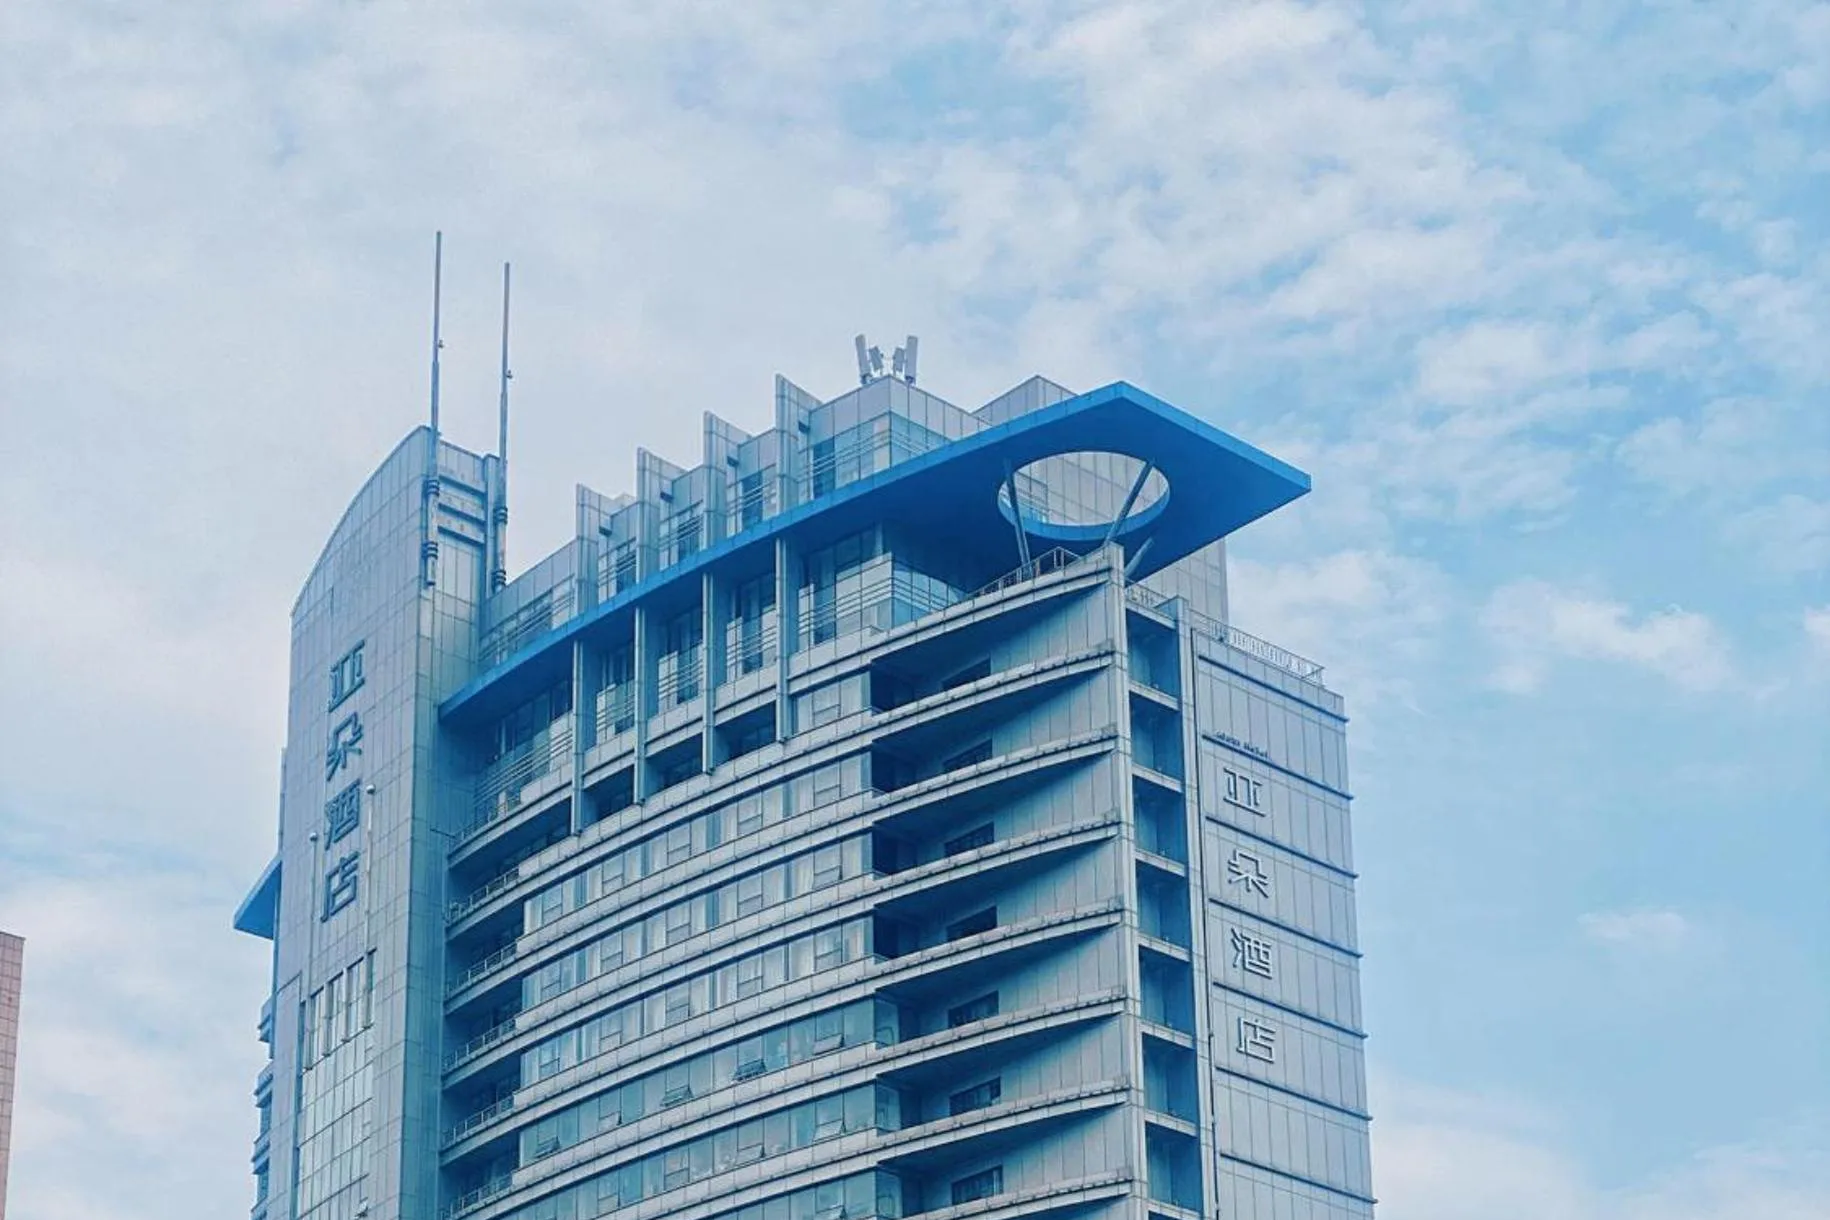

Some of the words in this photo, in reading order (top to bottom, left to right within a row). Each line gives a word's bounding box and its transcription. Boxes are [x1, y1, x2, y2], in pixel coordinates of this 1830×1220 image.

[320, 640, 366, 923] 亚朵酒店
[1223, 768, 1276, 1064] 亚朵酒店
